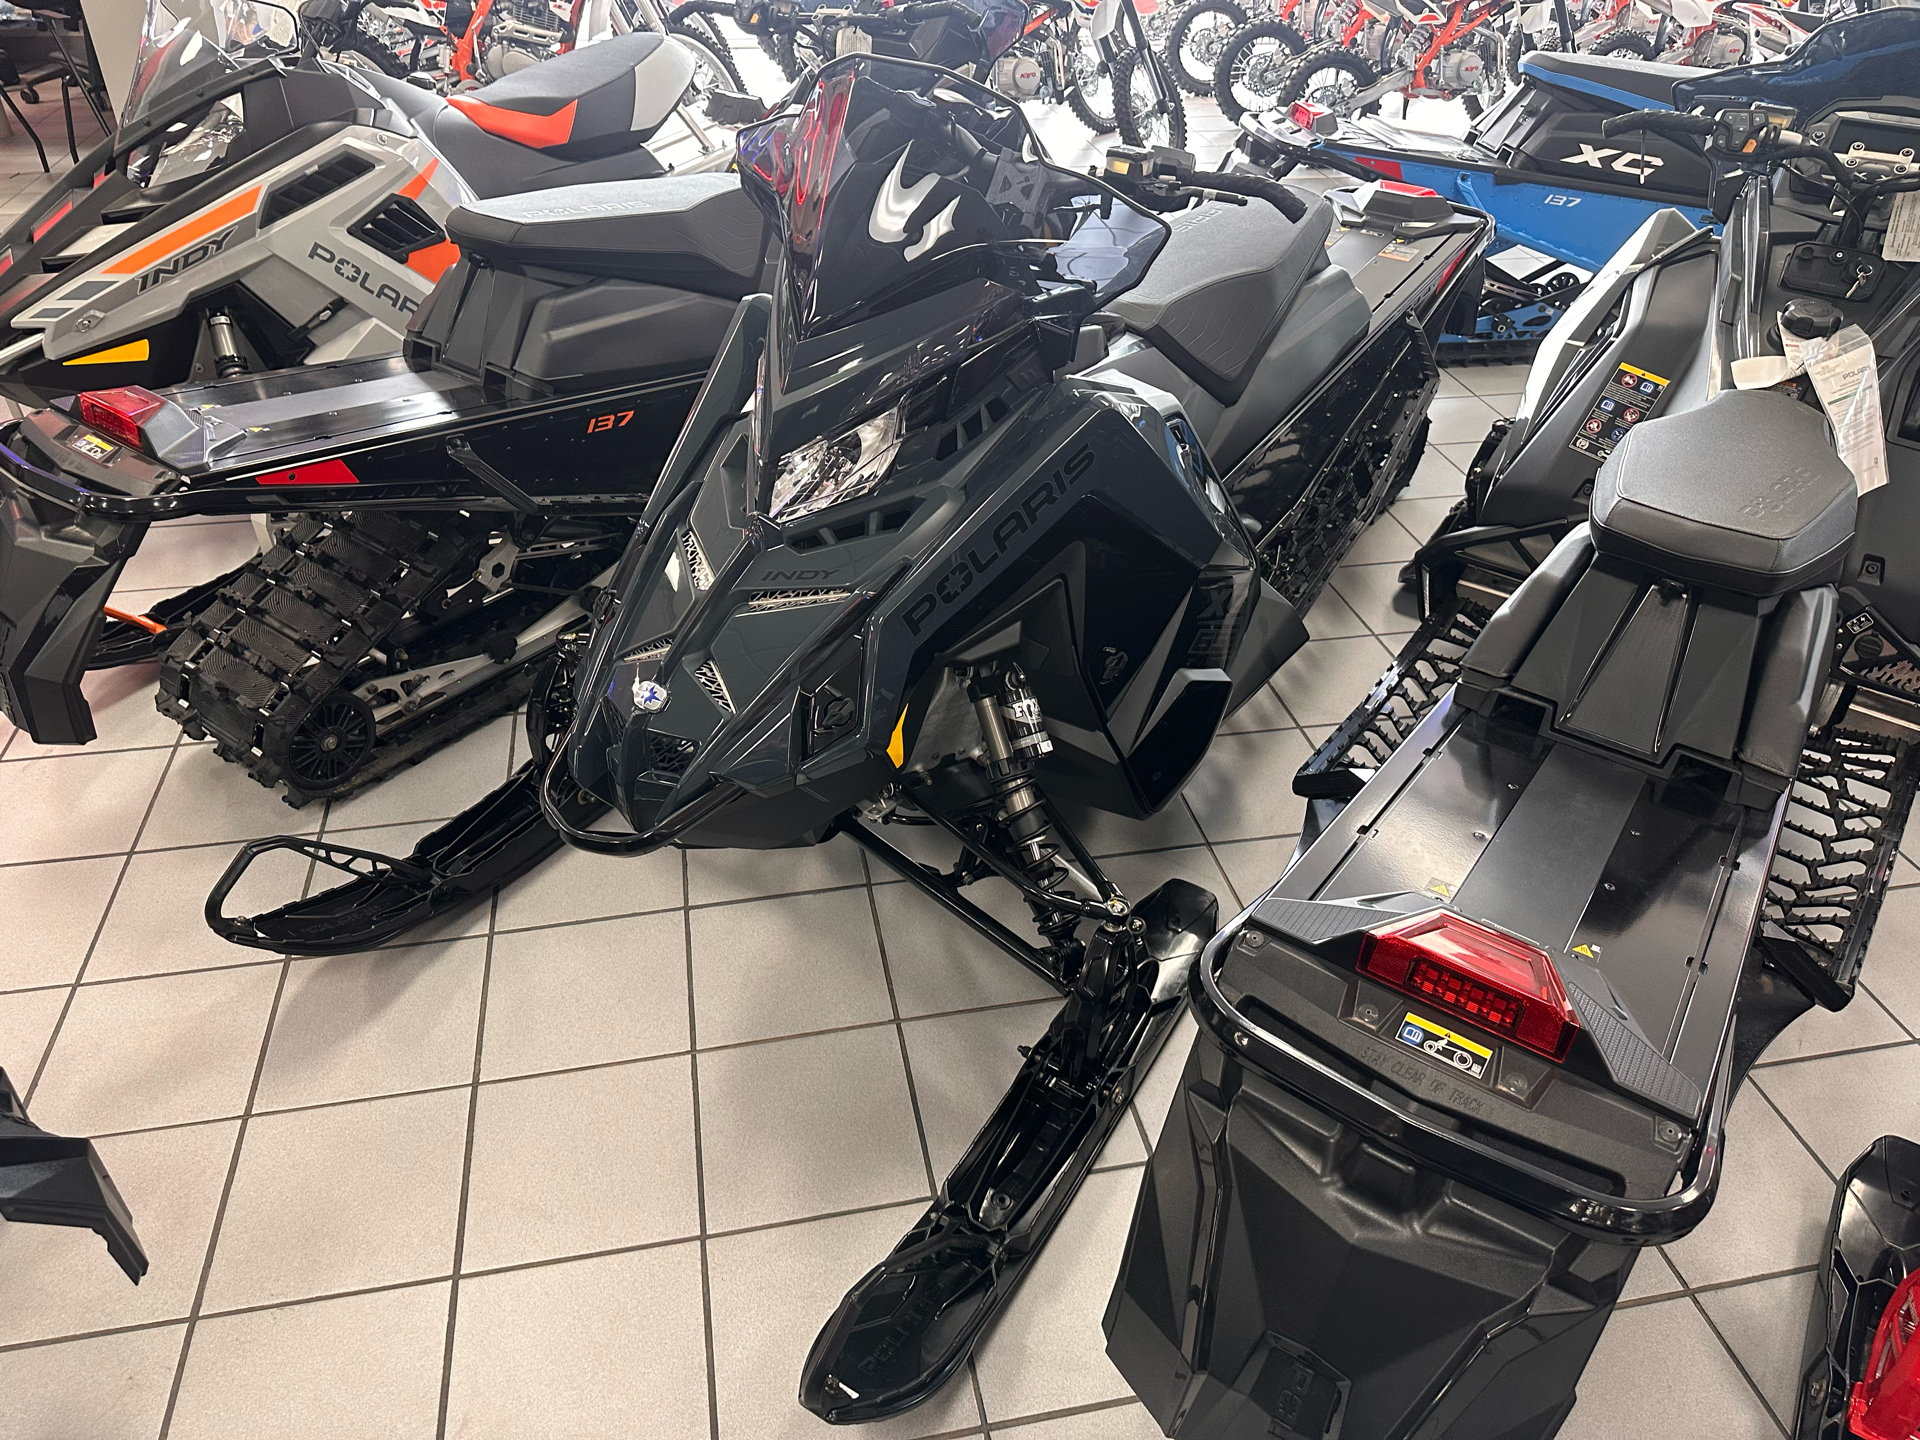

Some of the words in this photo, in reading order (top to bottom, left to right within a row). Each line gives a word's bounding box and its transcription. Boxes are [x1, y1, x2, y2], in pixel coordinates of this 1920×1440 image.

[1560, 143, 1665, 177] XC
[1543, 193, 1582, 208] 137
[135, 225, 238, 295] INDY
[587, 410, 635, 434] 137
[902, 442, 1095, 637] POLARIS
[761, 569, 841, 581] INDY
